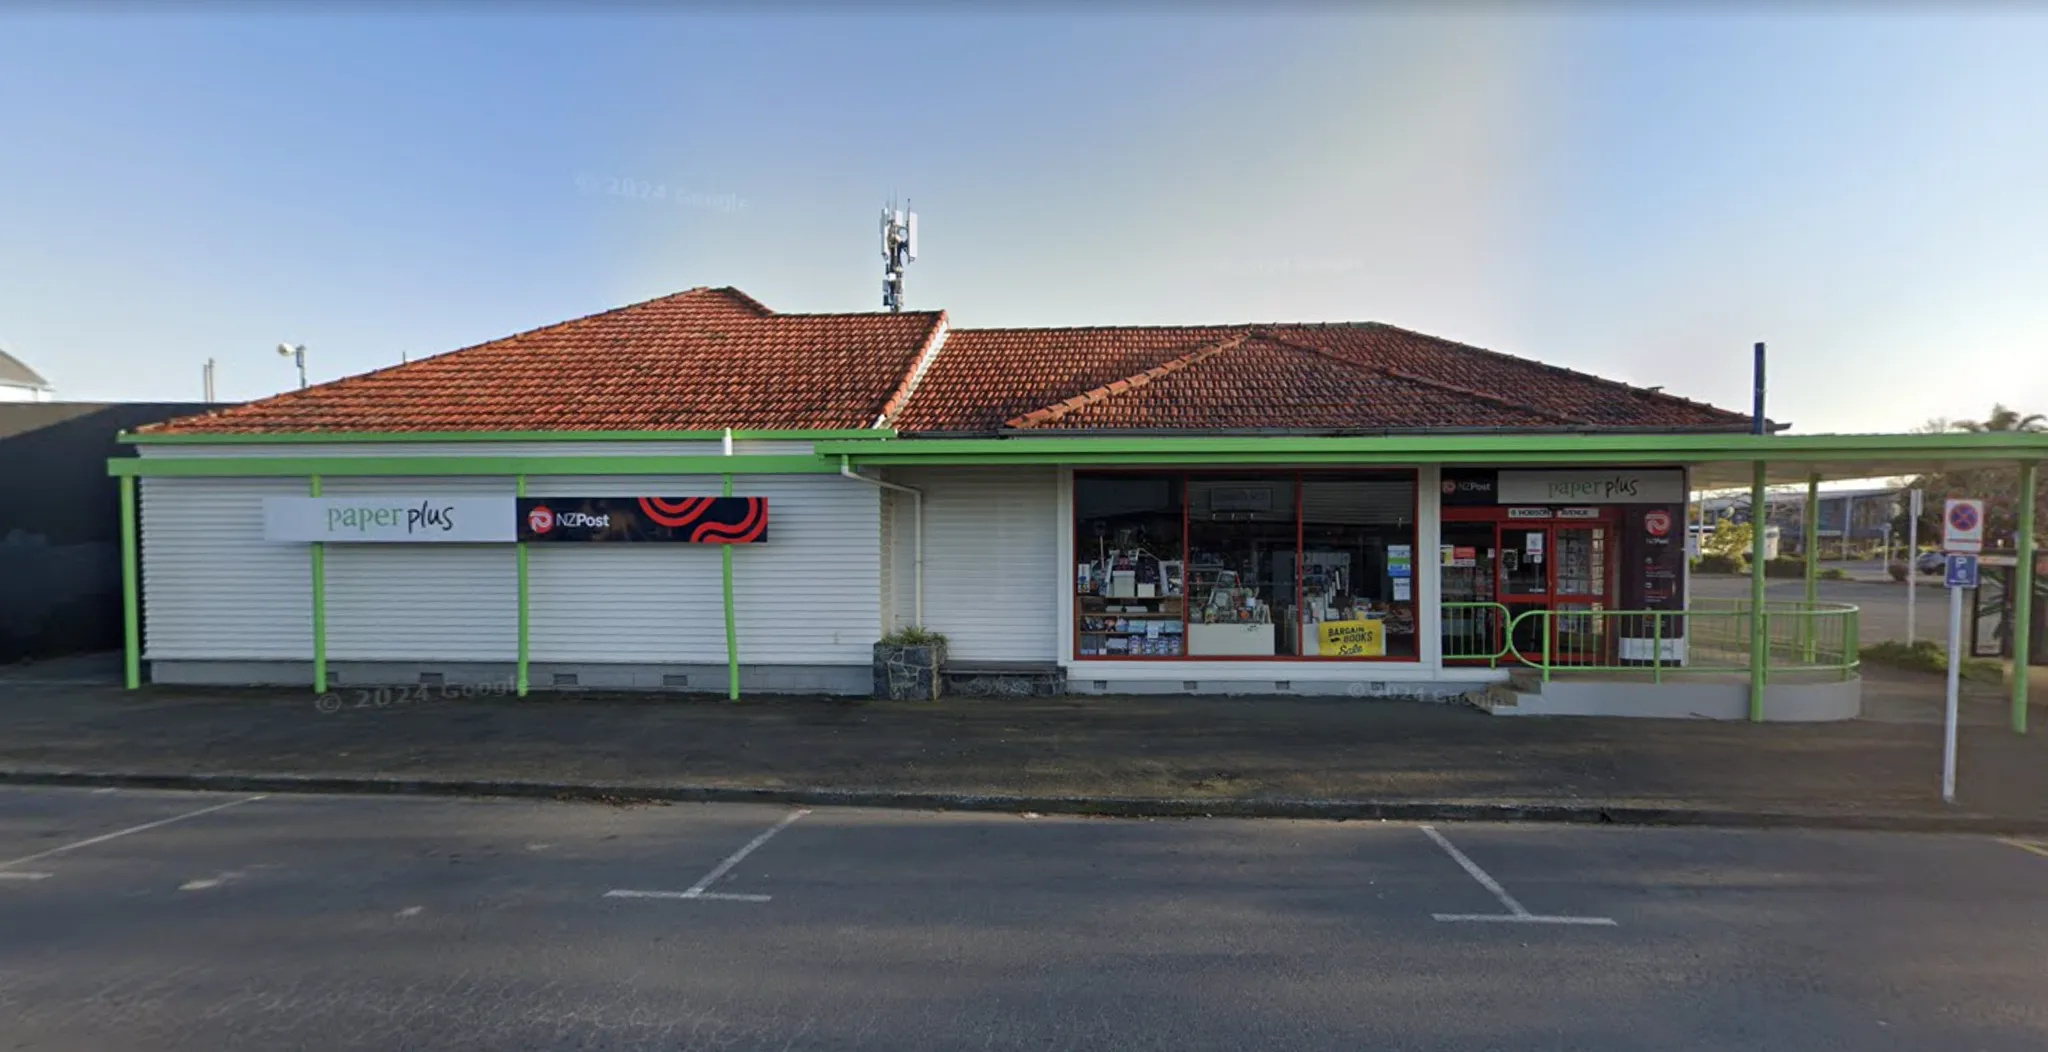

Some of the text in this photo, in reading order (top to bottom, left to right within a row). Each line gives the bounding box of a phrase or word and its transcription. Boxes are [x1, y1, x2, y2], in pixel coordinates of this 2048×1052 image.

[1548, 477, 1639, 498] paper plus
[327, 500, 454, 534] paper plus
[556, 512, 610, 528] NZPost
[1328, 626, 1365, 638] BARGAIN
[1343, 630, 1373, 643] BOOKS
